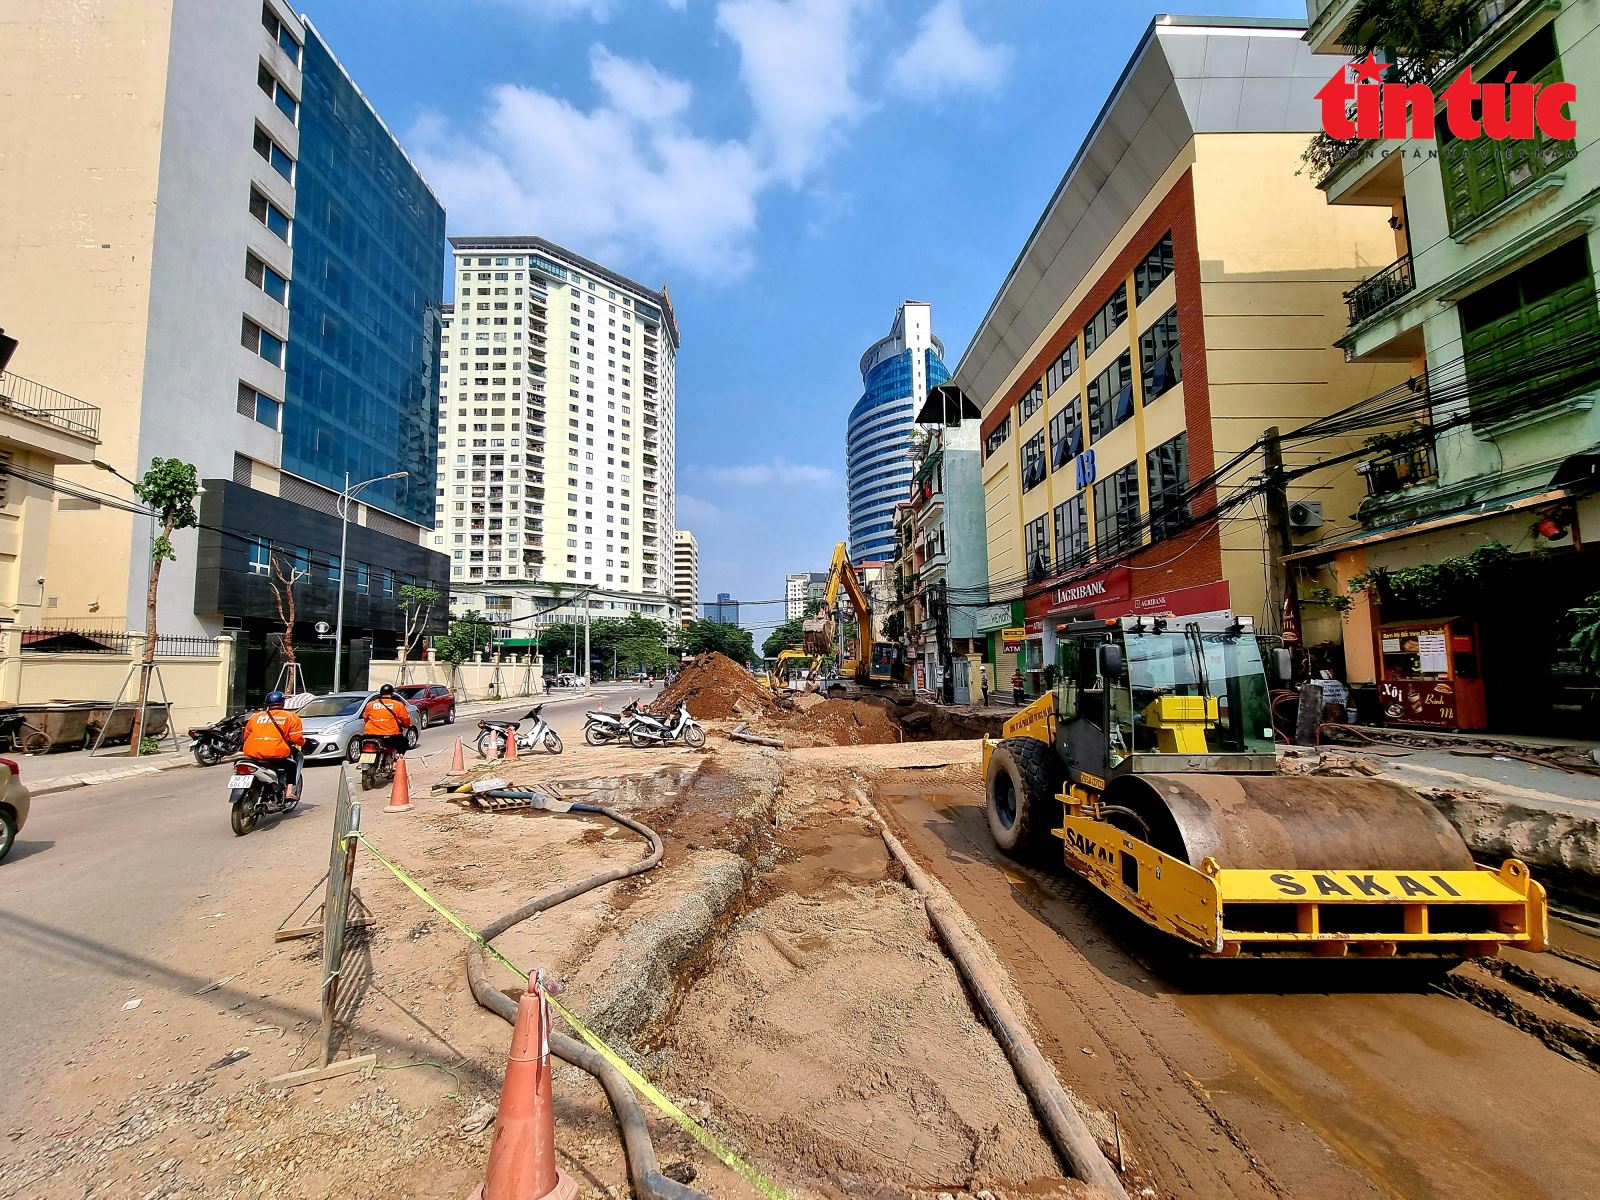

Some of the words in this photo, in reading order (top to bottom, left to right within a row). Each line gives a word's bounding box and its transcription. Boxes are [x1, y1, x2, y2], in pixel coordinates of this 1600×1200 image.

[1076, 449, 1096, 490] A3
[1060, 580, 1106, 603] AGRIBANK
[1382, 683, 1403, 702] Xôi
[1424, 694, 1445, 705] Bánh
[1066, 827, 1114, 864] SAKAI
[1269, 873, 1462, 896] SAKAI
